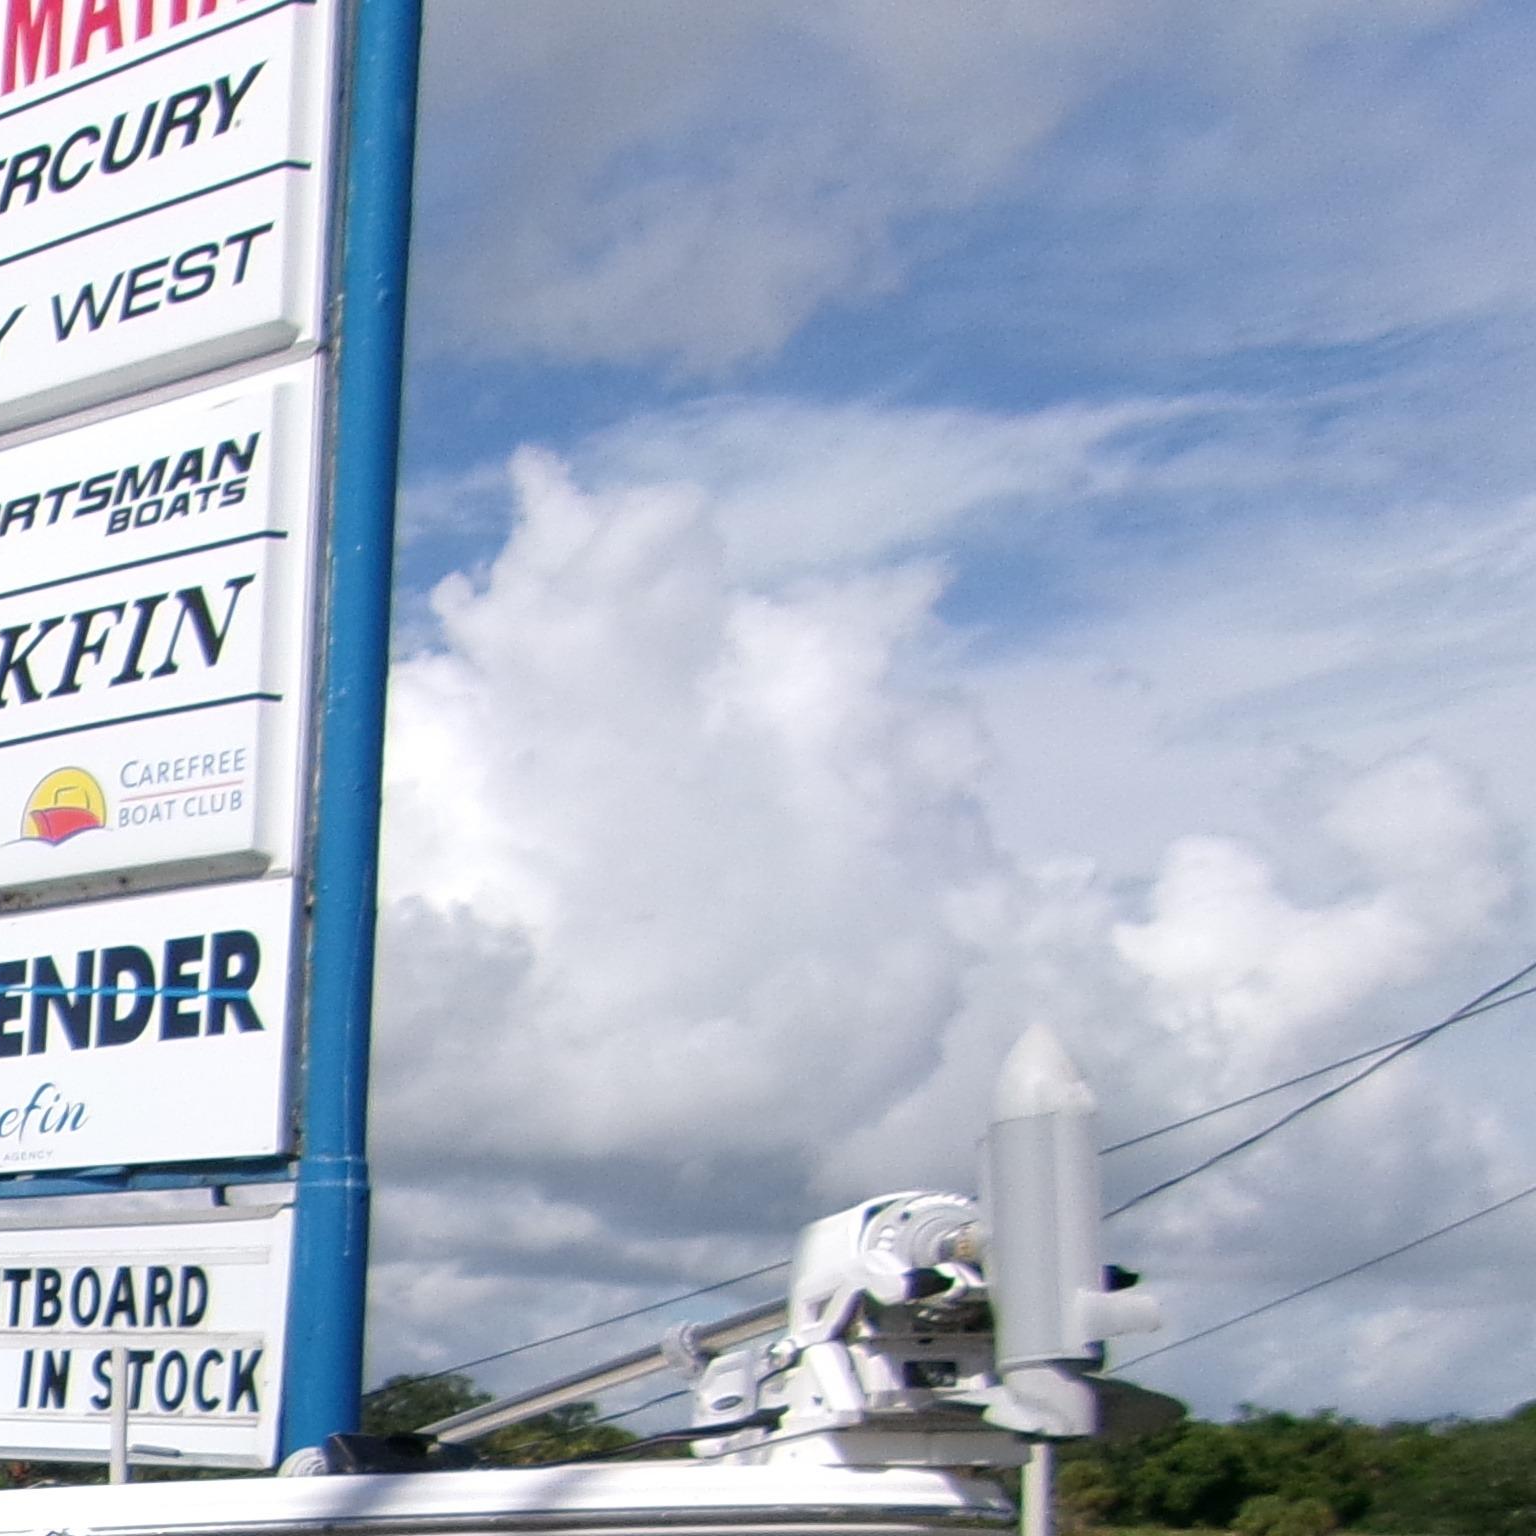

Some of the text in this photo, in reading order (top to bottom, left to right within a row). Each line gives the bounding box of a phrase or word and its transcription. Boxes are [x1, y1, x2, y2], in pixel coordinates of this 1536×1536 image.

[52, 222, 274, 342] WEST
[105, 478, 249, 536] BOATS
[119, 748, 247, 790] CAREFREE
[118, 789, 244, 829] BOAT CLUB
[3, 1149, 54, 1162] AGENCY
[18, 1349, 72, 1408] IN
[89, 1348, 263, 1412] STOCK
